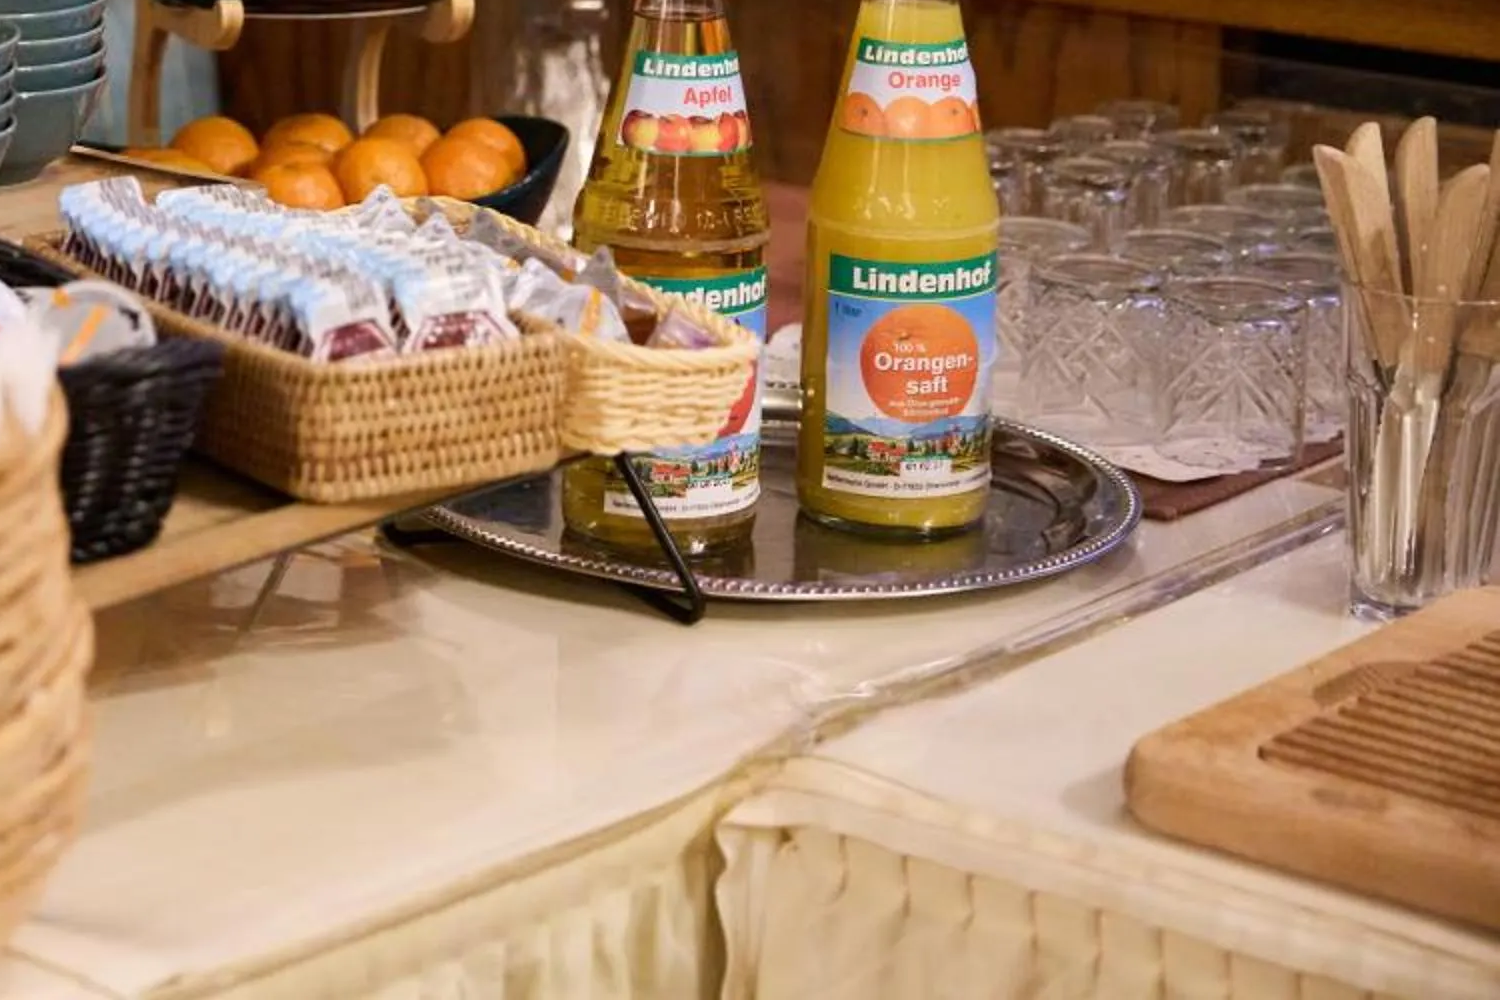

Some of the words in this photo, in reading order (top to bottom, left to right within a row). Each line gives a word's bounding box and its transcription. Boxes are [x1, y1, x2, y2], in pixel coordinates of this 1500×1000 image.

[888, 71, 961, 91] Orange
[684, 86, 733, 108] Apfel
[852, 260, 992, 293] Lindenhof
[875, 352, 974, 375] Orangen-
[905, 375, 948, 395] saft
